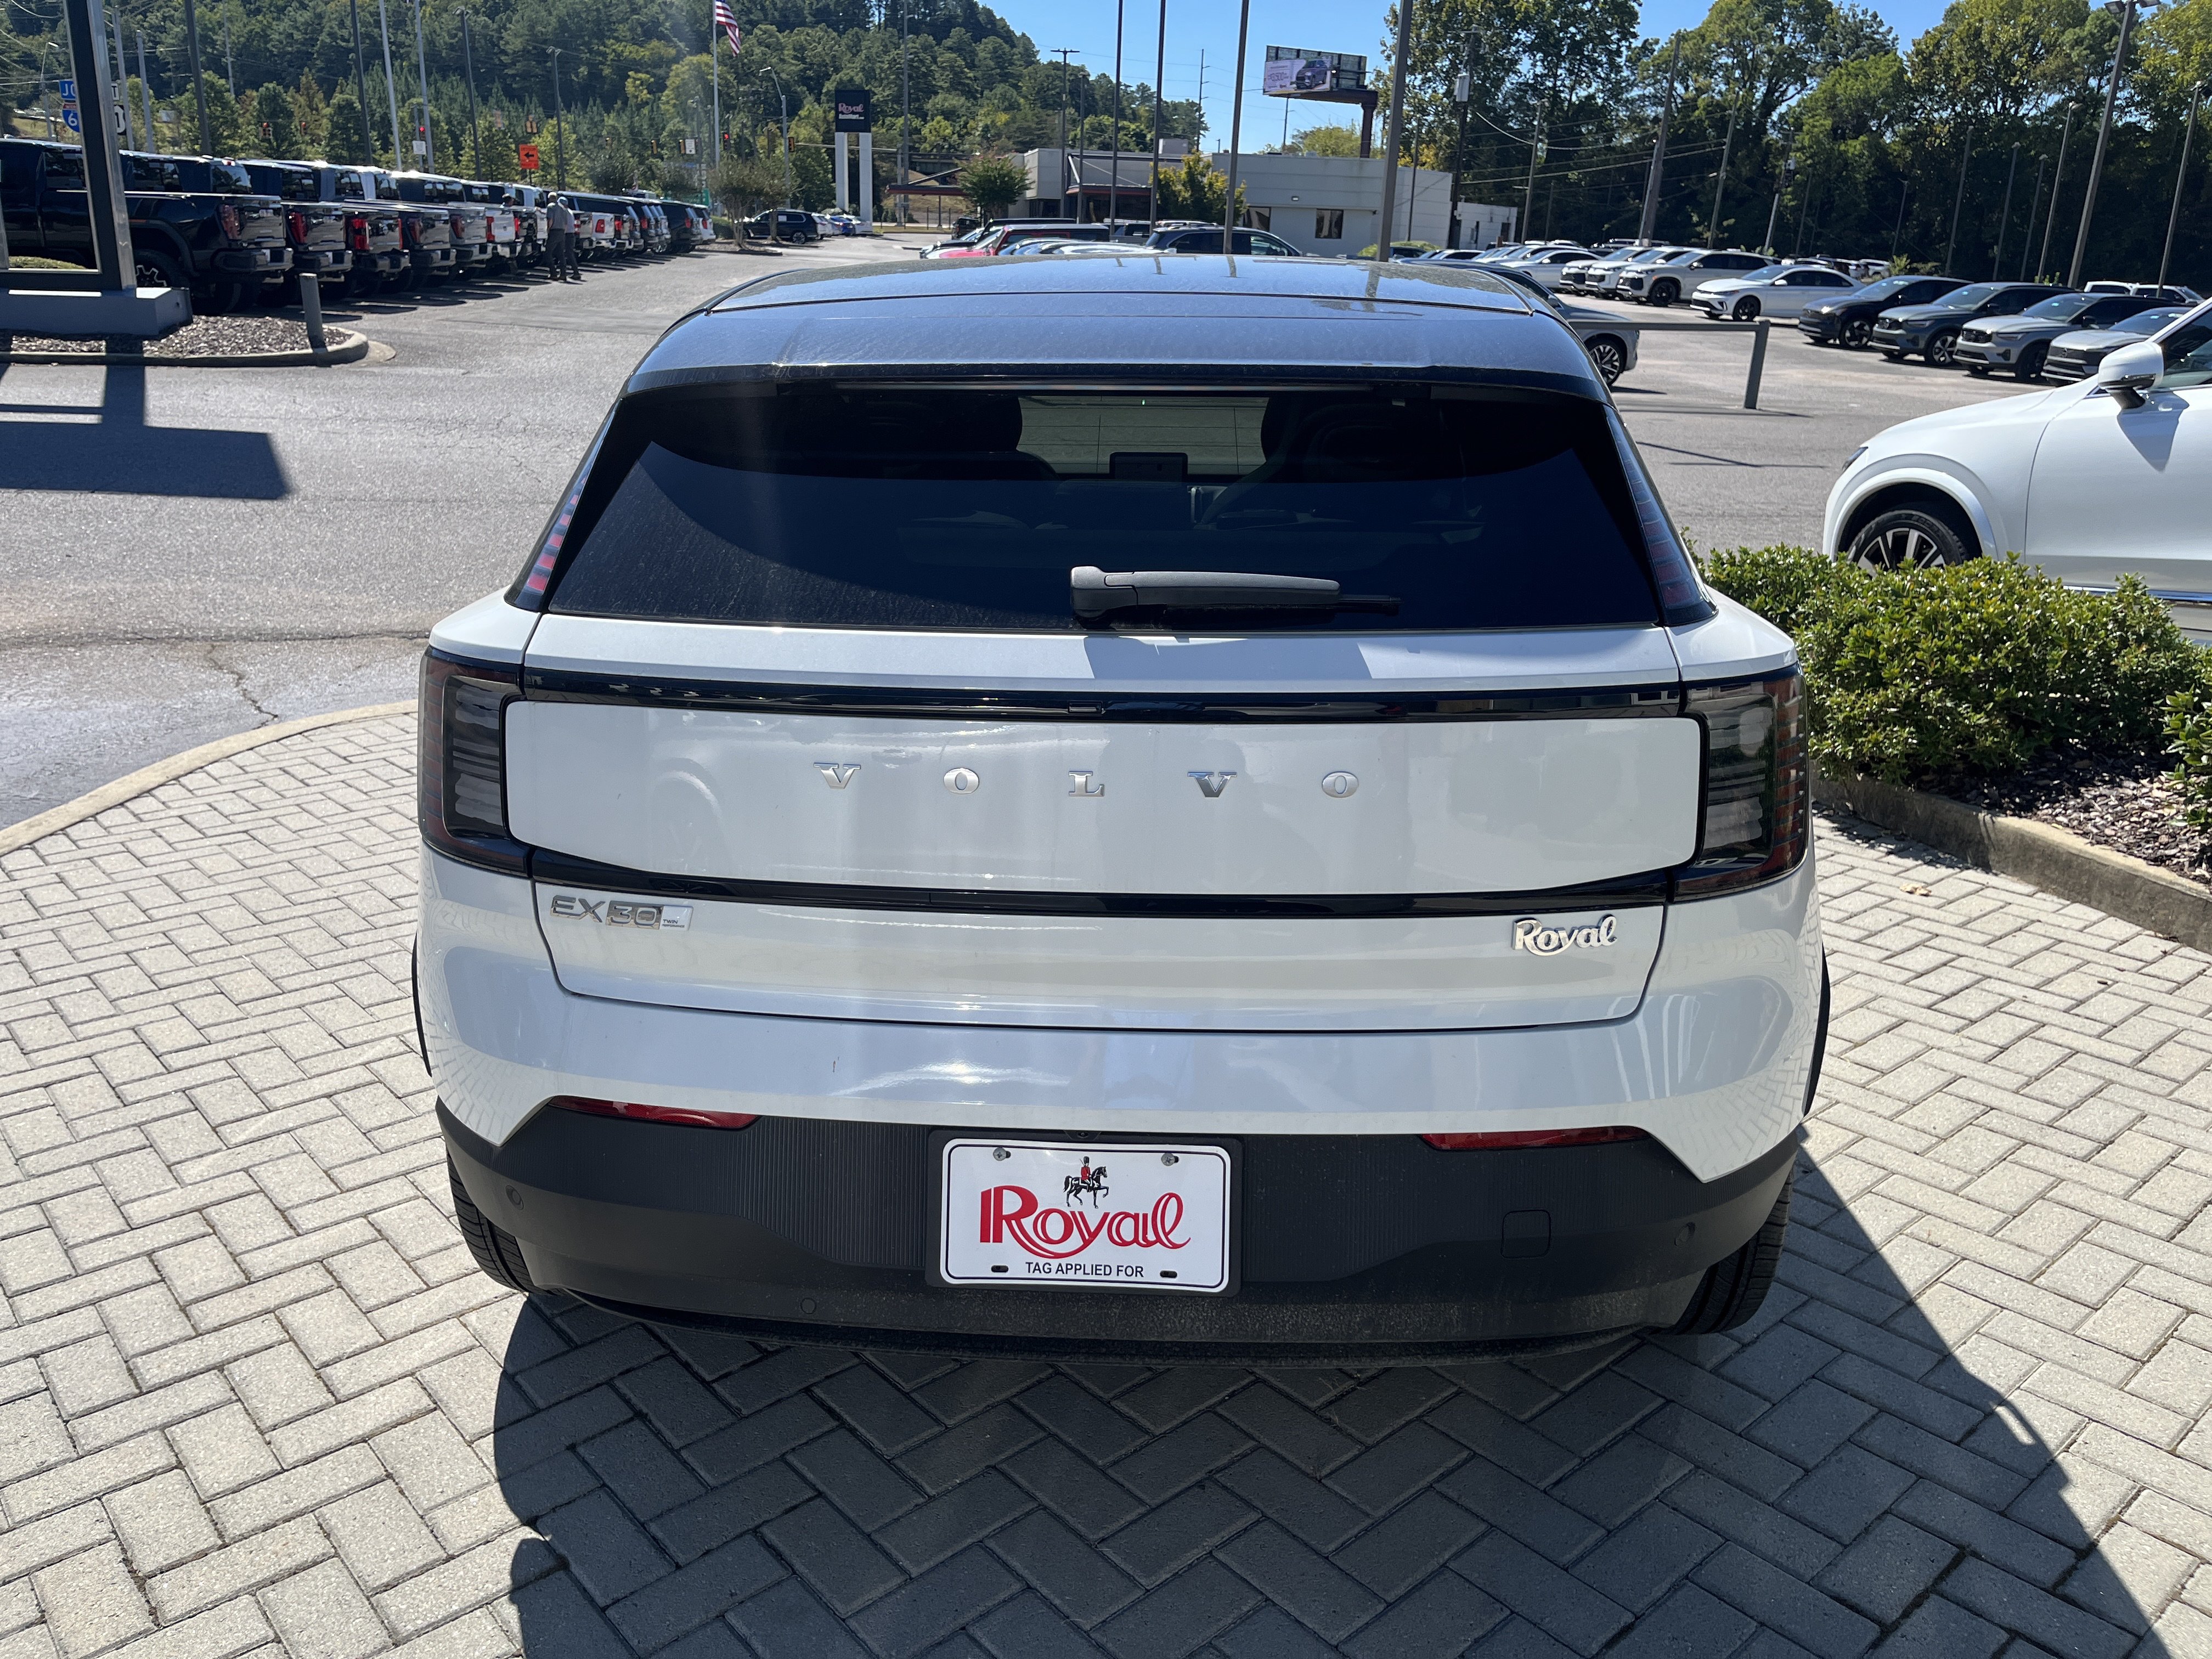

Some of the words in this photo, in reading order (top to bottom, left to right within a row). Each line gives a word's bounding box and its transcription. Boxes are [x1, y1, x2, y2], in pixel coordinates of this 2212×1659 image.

[62, 83, 76, 96] JC
[68, 112, 77, 126] 6
[838, 103, 864, 114] Royal
[814, 762, 1359, 798] VOLVO
[550, 895, 660, 928] EX30
[1512, 914, 1617, 956] Royal
[980, 1185, 1191, 1259] Royal
[1025, 1262, 1052, 1274] TAG
[1055, 1263, 1112, 1277] APPLIED
[1116, 1265, 1144, 1277] FOR
